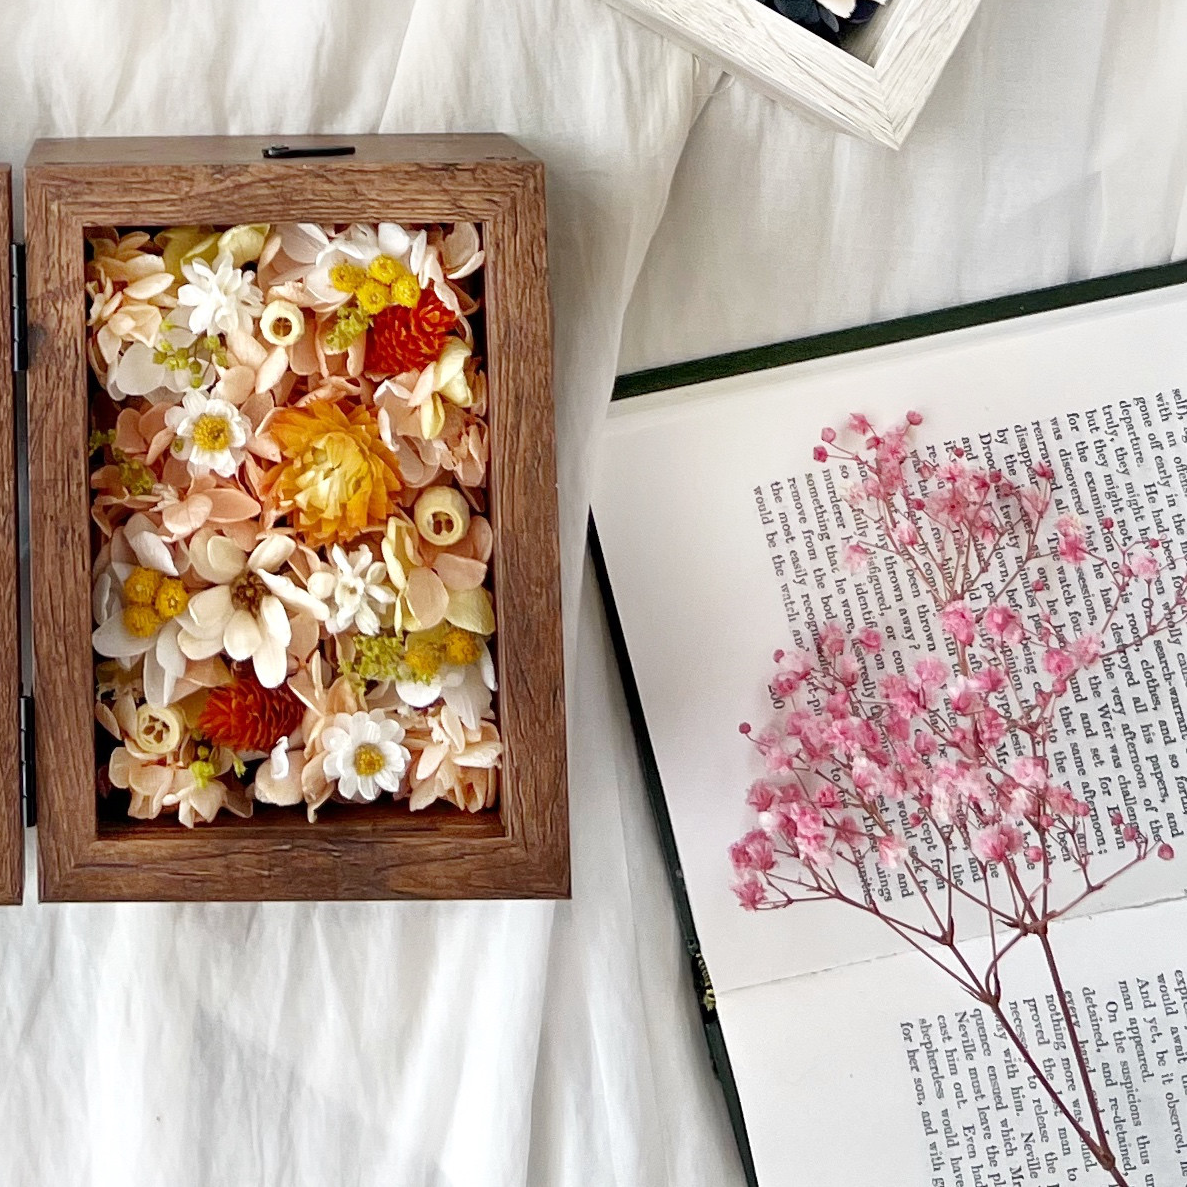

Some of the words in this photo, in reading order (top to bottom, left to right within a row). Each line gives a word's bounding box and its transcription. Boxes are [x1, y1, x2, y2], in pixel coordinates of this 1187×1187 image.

[1049, 416, 1063, 441] was
[1132, 396, 1153, 428] gone
[1155, 392, 1173, 423] with
[1165, 431, 1177, 448] an
[1147, 432, 1164, 451] off
[1085, 408, 1101, 434] but
[1093, 439, 1109, 468] they
[1103, 473, 1125, 515] might
[1116, 518, 1133, 548] not,
[1101, 404, 1122, 443] truly,
[1114, 446, 1131, 476] they
[1124, 481, 1146, 523] might
[1118, 400, 1144, 468] departure.
[1143, 482, 1159, 504] He
[1151, 508, 1170, 535] had
[1154, 455, 1173, 488] early
[821, 468, 847, 529] murderer
[1058, 448, 1090, 516] discovered
[753, 485, 775, 525] would
[804, 472, 831, 542] something
[1165, 493, 1179, 508] in
[765, 530, 778, 549] be
[770, 481, 783, 504] the
[778, 511, 796, 544] most
[789, 549, 808, 586] easily
[787, 477, 807, 524] remove
[801, 529, 818, 561] from
[812, 567, 827, 590] the
[1171, 513, 1187, 536] the
[771, 554, 786, 577] the
[883, 555, 904, 603] thrown
[1091, 561, 1105, 580] he
[780, 582, 801, 623] watch
[834, 577, 847, 595] he
[1066, 412, 1080, 432] for
[1075, 440, 1089, 463] the
[1140, 659, 1161, 711] clothes,
[1158, 719, 1176, 746] and
[1168, 753, 1180, 769] so
[840, 598, 856, 635] wore,
[961, 437, 979, 462] and
[1017, 636, 1038, 675] being
[1053, 750, 1068, 774] the
[994, 427, 1009, 445] by
[1003, 454, 1018, 477] the
[1045, 597, 1059, 616] he
[1079, 712, 1098, 739] and
[1089, 747, 1105, 768] set
[1098, 776, 1112, 797] for
[916, 604, 937, 653] thrown
[838, 464, 850, 480] so
[885, 625, 897, 641] or
[951, 864, 964, 888] the
[1056, 565, 1075, 608] watch
[1087, 675, 1102, 698] the
[1097, 702, 1115, 740] Weir
[1109, 743, 1123, 769] was
[1110, 685, 1127, 716] very
[1131, 696, 1149, 714] all
[1058, 705, 1077, 736] that
[1069, 742, 1087, 777] same
[1139, 723, 1156, 745] his
[993, 742, 1010, 771] Mr.
[1120, 723, 1147, 790] afternoon
[1145, 754, 1170, 804] papers,
[1143, 798, 1159, 813] of
[1148, 819, 1164, 843] the
[1166, 812, 1185, 839] and
[897, 873, 915, 899] and
[1135, 977, 1157, 1009] And
[937, 1014, 953, 1044] cast
[1081, 986, 1110, 1053] detained,
[1105, 1001, 1119, 1024] On
[1142, 1016, 1161, 1044] yet,
[1157, 972, 1179, 1017] would
[1170, 1026, 1187, 1065] await
[899, 1021, 914, 1043] for
[954, 1010, 977, 1061] Neville
[1112, 1030, 1127, 1054] the
[1118, 980, 1134, 1012] man
[1126, 1017, 1155, 1083] appeared.
[906, 1048, 920, 1073] her
[944, 1047, 960, 1076] him
[1003, 1047, 1020, 1080] with
[1044, 991, 1067, 1051] nothing
[1060, 1057, 1076, 1092] more
[1072, 1098, 1084, 1124] was
[1101, 1062, 1119, 1088] and
[1155, 1049, 1169, 1067] be
[913, 1077, 926, 1106] son,
[918, 1018, 945, 1100] shepherdess
[941, 1108, 960, 1149] would
[953, 1081, 968, 1110] out.
[968, 1066, 986, 1102] must
[969, 1007, 992, 1057] quence
[987, 1065, 1009, 1112] ensued
[999, 1117, 1018, 1157] which
[1022, 997, 1051, 1046] proved
[1042, 1057, 1056, 1081] the
[1057, 1126, 1071, 1157] man
[1066, 1167, 1078, 1182] to
[1119, 1060, 1142, 1127] suspicions
[1161, 1072, 1174, 1086] it
[1010, 1085, 1026, 1117] him.
[921, 1110, 939, 1137] and
[976, 1105, 992, 1140] leave
[1031, 1097, 1050, 1143] release
[1044, 1151, 1059, 1174] the
[1108, 1097, 1137, 1177] re-detained,
[1165, 1091, 1187, 1154] observed,
[929, 1141, 946, 1172] with
[962, 1123, 977, 1159] Even
[985, 1144, 1000, 1168] the
[1020, 1131, 1042, 1179] Neville
[1136, 1135, 1151, 1165] thus
